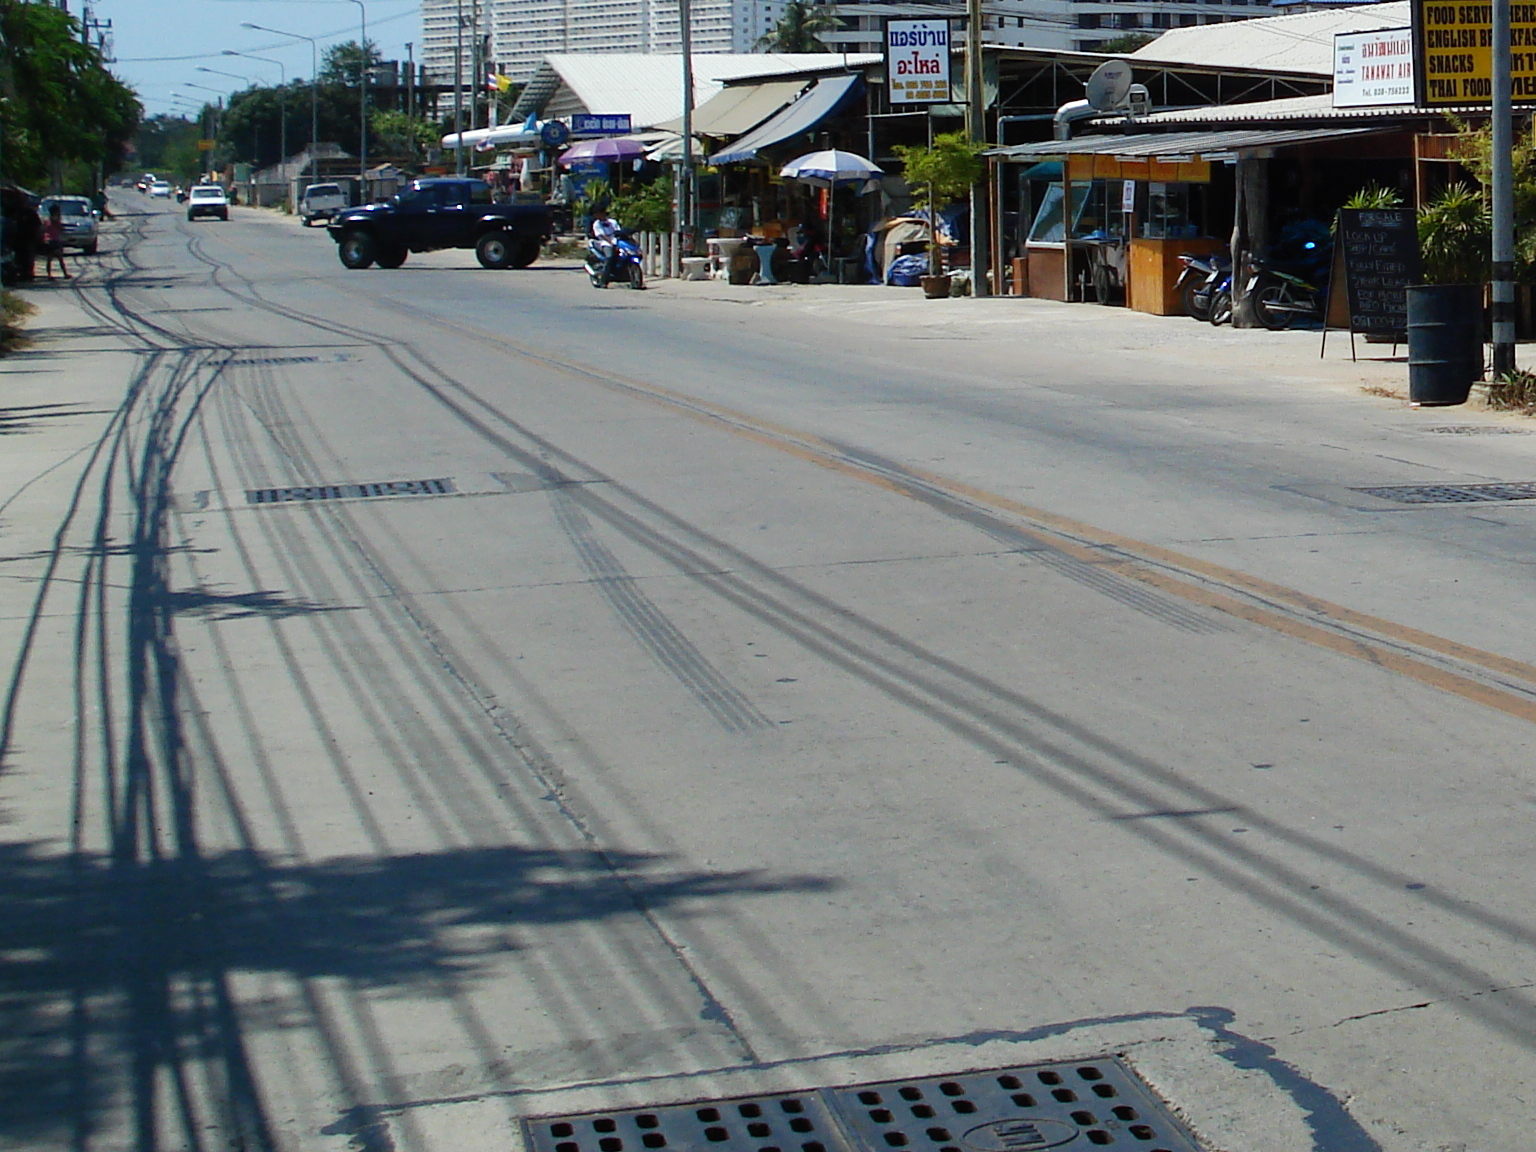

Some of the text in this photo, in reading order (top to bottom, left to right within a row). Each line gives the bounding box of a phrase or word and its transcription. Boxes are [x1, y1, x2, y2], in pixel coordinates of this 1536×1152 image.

[1427, 6, 1455, 25] FOOD
[890, 24, 946, 47] แอร์บ้าน
[1427, 29, 1476, 48] ENGLISH
[897, 51, 941, 74] อะไหล่
[1398, 62, 1411, 79] AIR
[1429, 54, 1474, 74] SNACKS
[1429, 79, 1457, 98] THAI
[1463, 78, 1492, 97] FOOD
